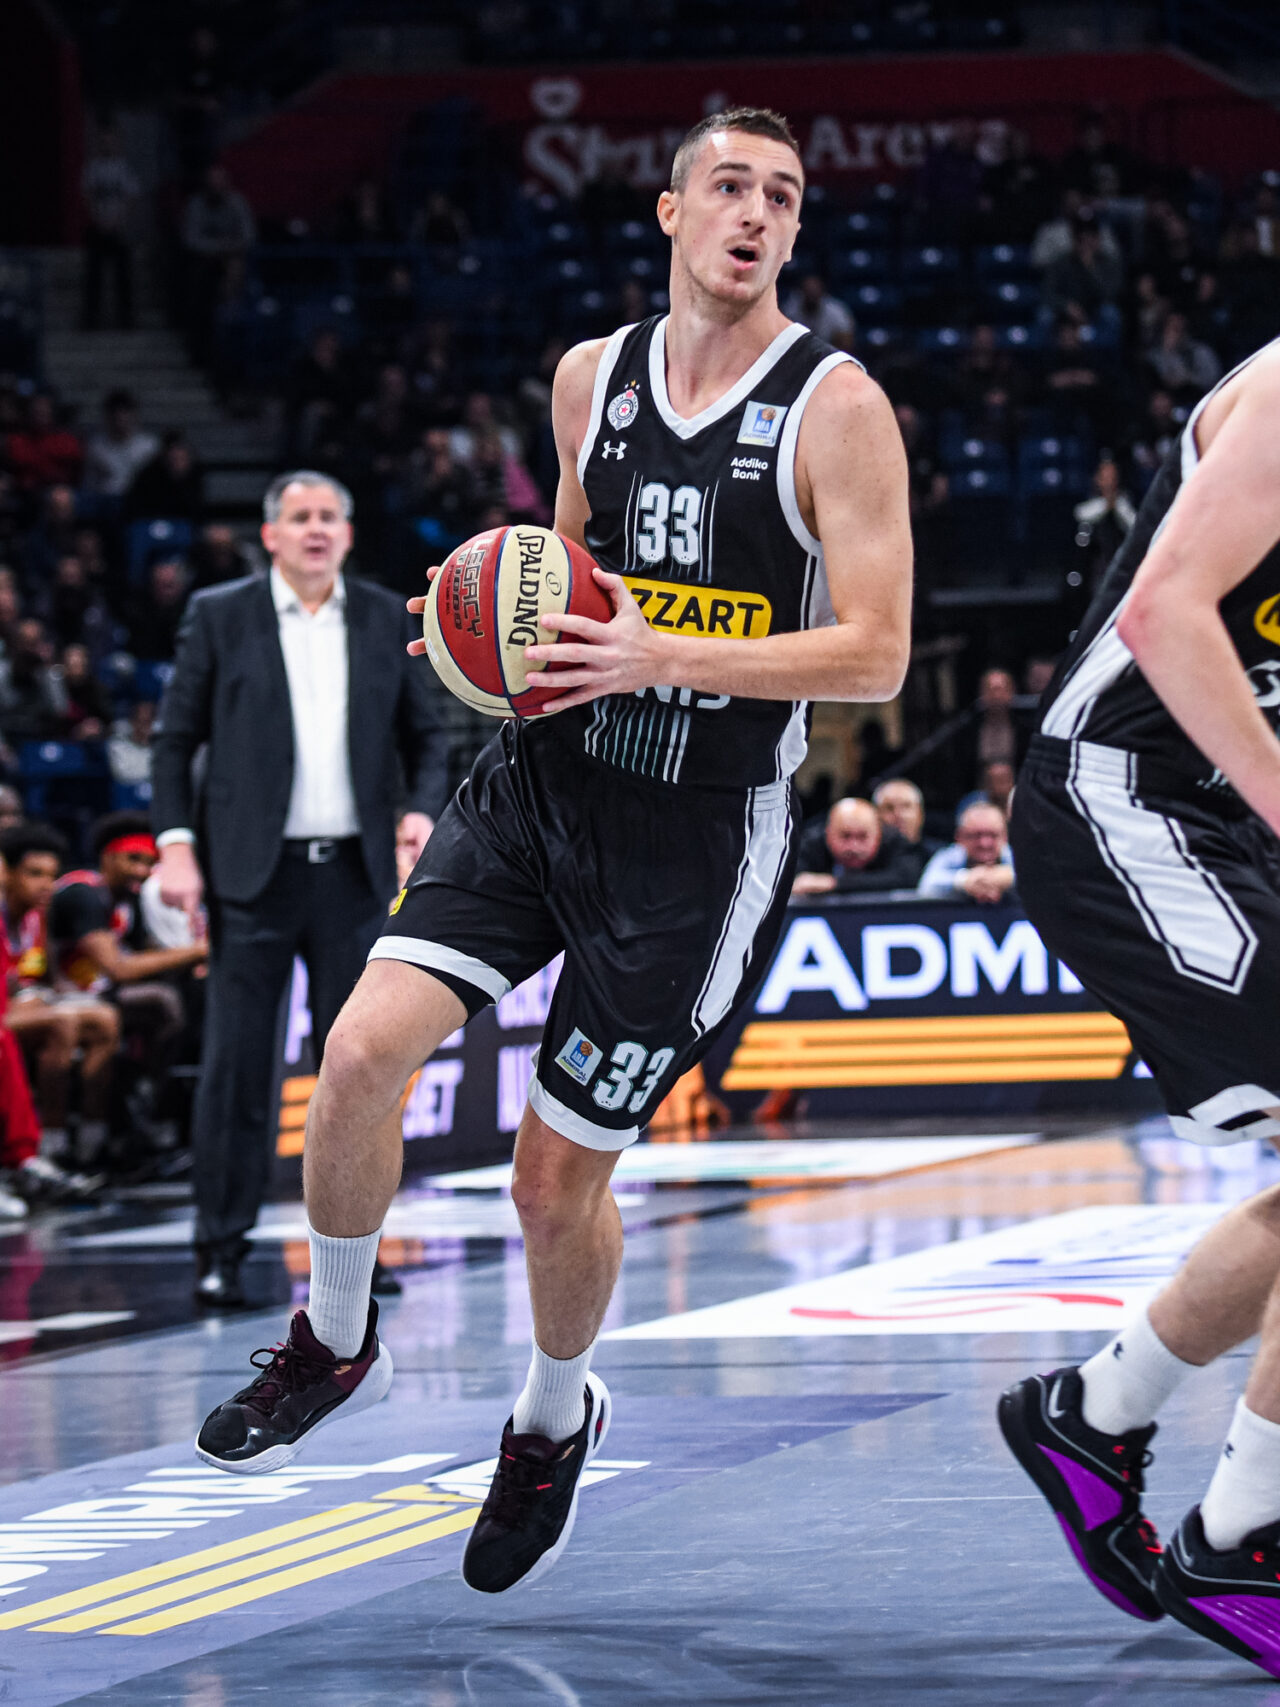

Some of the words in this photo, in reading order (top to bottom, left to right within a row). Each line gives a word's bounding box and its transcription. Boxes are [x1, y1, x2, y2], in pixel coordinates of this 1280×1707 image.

[731, 457, 768, 470] Addiko
[732, 468, 760, 480] Bank
[637, 482, 702, 566] 33
[463, 538, 495, 638] LEGACY
[507, 532, 546, 647] SPALDING
[631, 587, 765, 637] ZZART
[592, 1041, 676, 1114] 33
